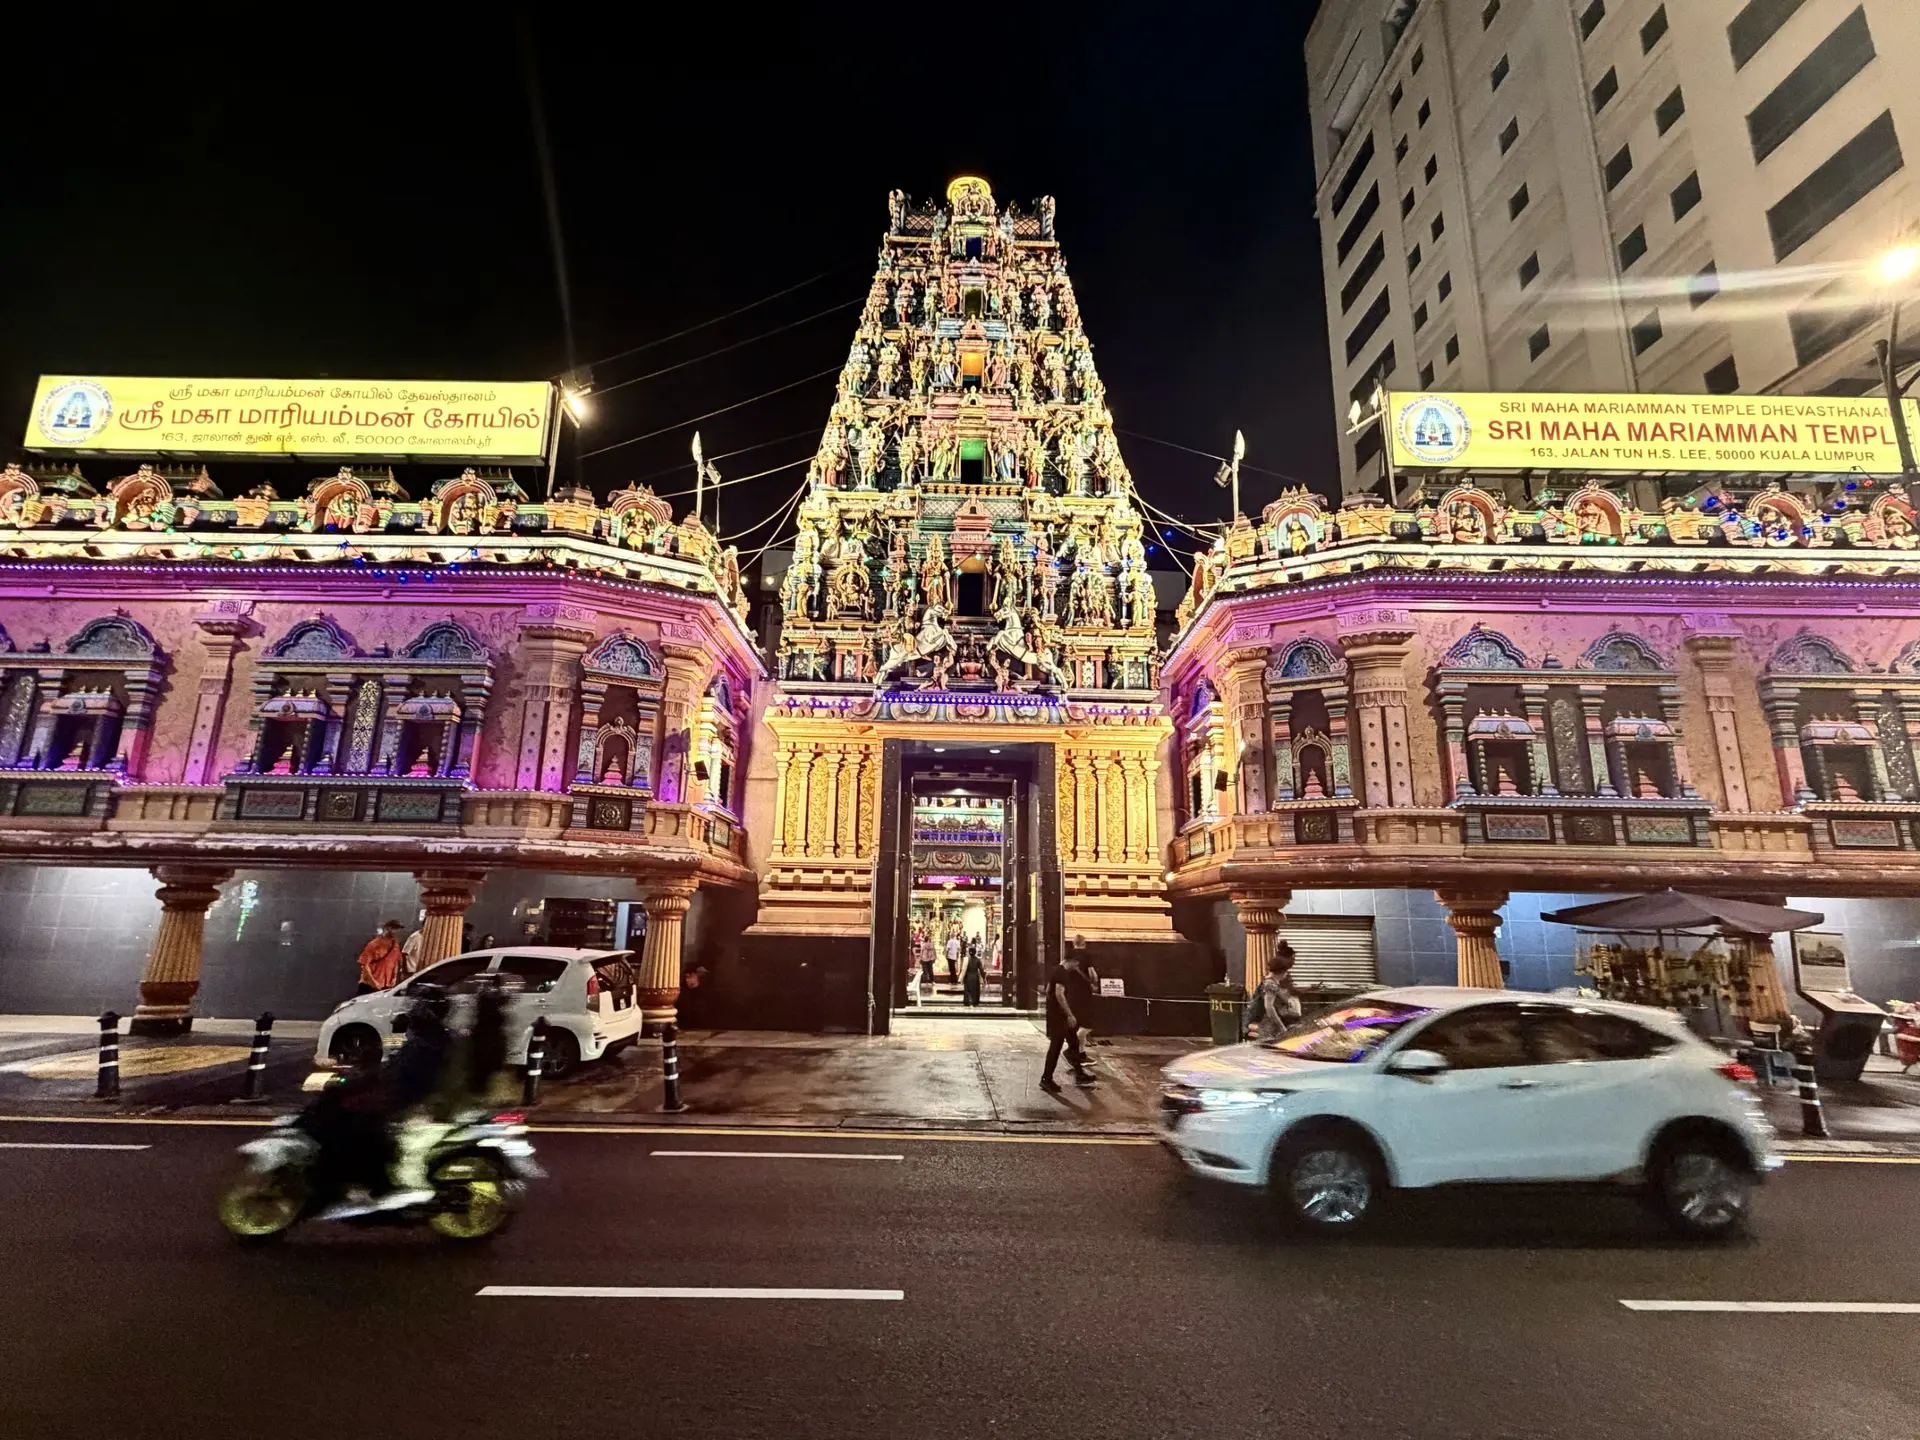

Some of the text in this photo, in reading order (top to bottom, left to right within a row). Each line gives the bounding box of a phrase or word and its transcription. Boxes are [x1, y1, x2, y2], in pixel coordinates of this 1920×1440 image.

[197, 388, 230, 397] மகா
[235, 386, 325, 400] மாரியம்மன்
[330, 387, 393, 400] கோயில்
[172, 409, 232, 424] மகா
[239, 401, 416, 429] மாரியம்மன்
[424, 407, 541, 430] கோயில்
[1500, 402, 1525, 412] SRI
[1532, 402, 1579, 413] MAHA
[1584, 403, 1686, 414] MARIAMMAN
[1692, 404, 1756, 415] TEMPLE
[161, 432, 187, 443] 163,
[193, 432, 242, 442] ஜாலான்
[356, 435, 404, 444] 50000
[1488, 420, 1896, 445] SRI MAHA MARIAMMAN TEMPL
[1530, 448, 1876, 462] 163, JALAN TUN H.S. LEE, 50000 KUALA LUMPUR
